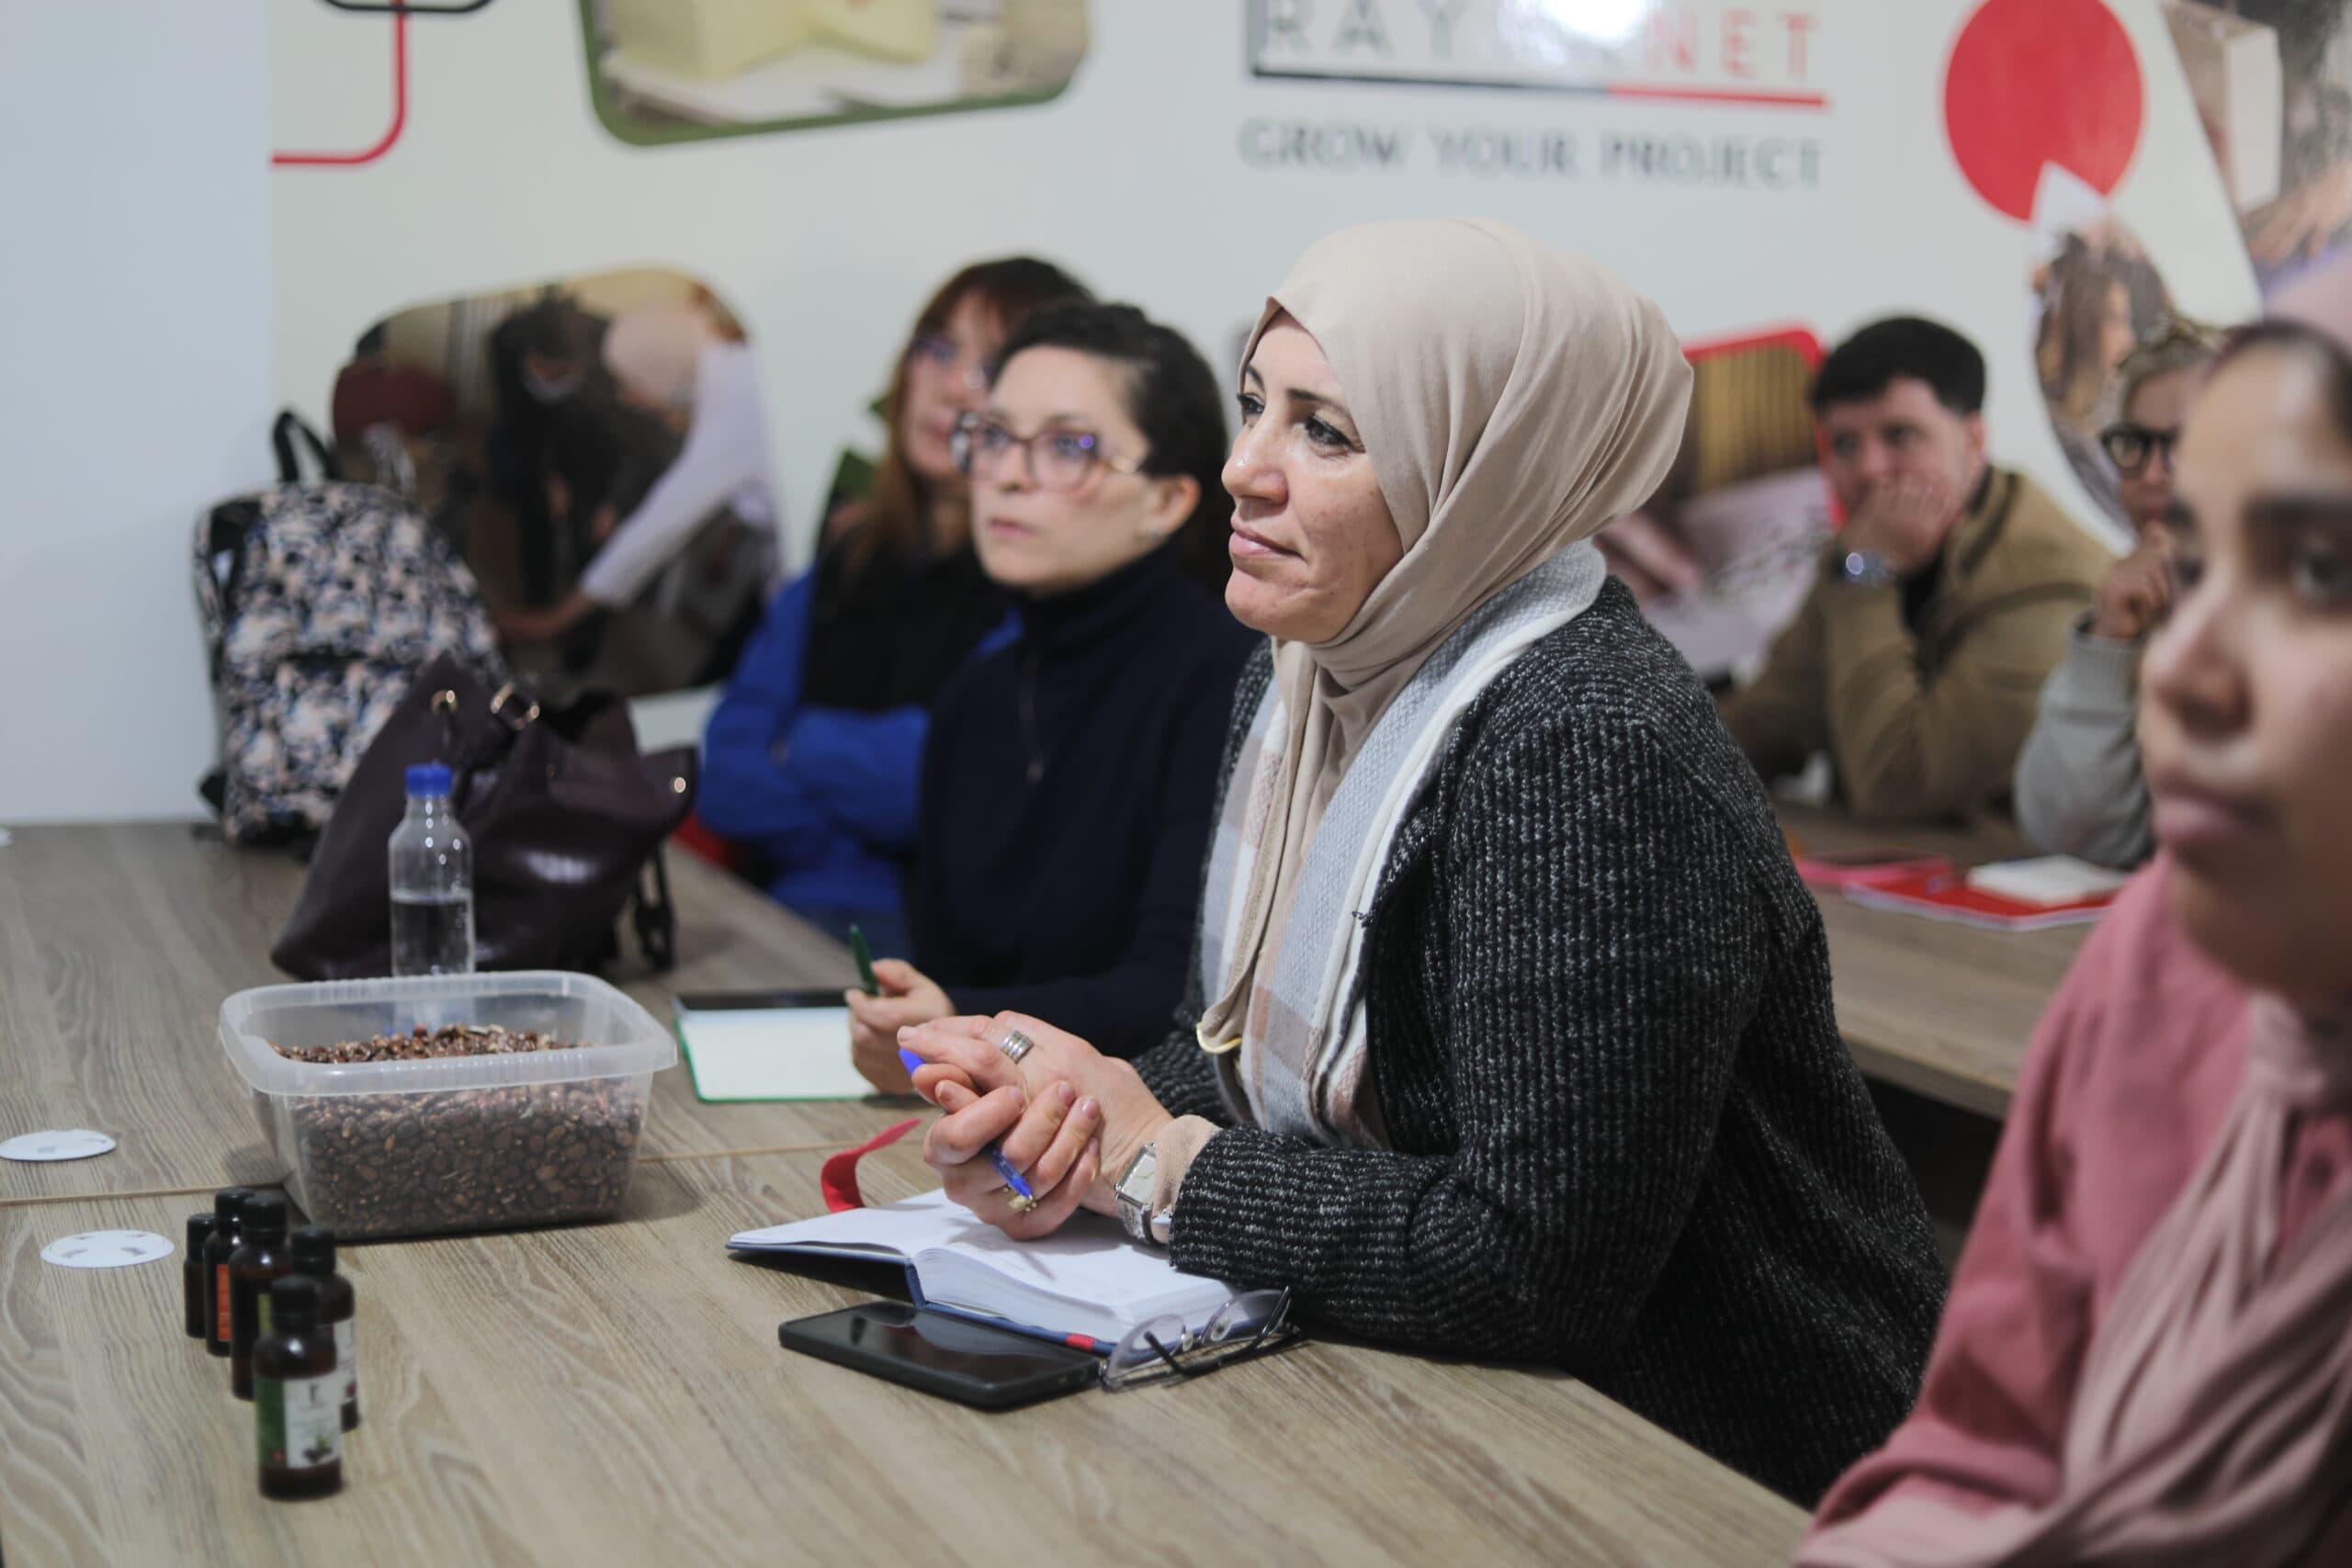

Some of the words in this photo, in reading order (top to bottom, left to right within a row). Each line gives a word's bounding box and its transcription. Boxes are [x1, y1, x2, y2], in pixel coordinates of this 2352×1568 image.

[1238, 117, 1408, 171] GROW
[1429, 123, 1578, 179] YOUR
[1601, 131, 1822, 189] PROJECT
